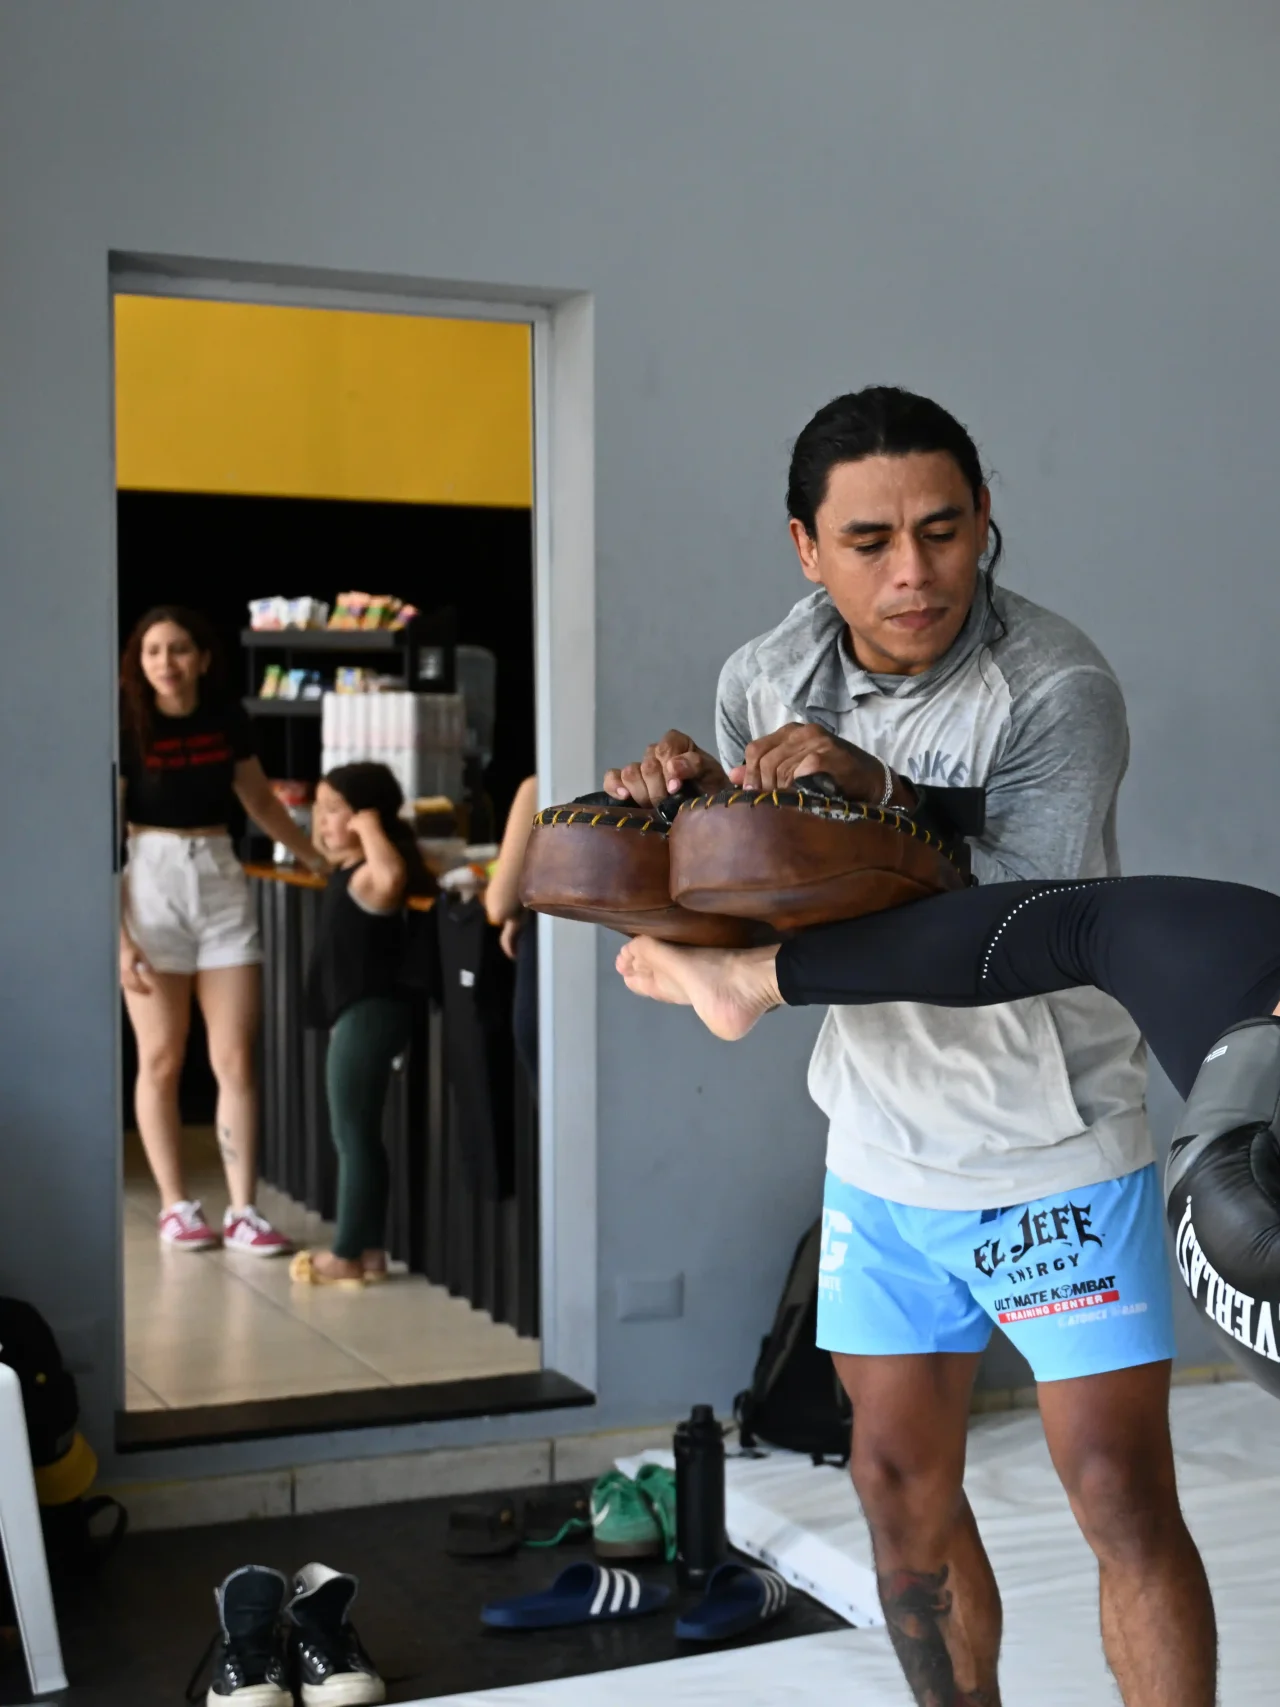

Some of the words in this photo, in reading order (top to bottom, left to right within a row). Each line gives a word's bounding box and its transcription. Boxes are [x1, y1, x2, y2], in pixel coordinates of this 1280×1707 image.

[973, 1238, 1006, 1278] EL
[1010, 1200, 1103, 1263] JEFE
[1007, 1253, 1079, 1284] ENERGY
[994, 1290, 1049, 1311] ULTMATE
[1005, 1307, 1050, 1322] TRAINING
[1053, 1294, 1104, 1312] CENTER
